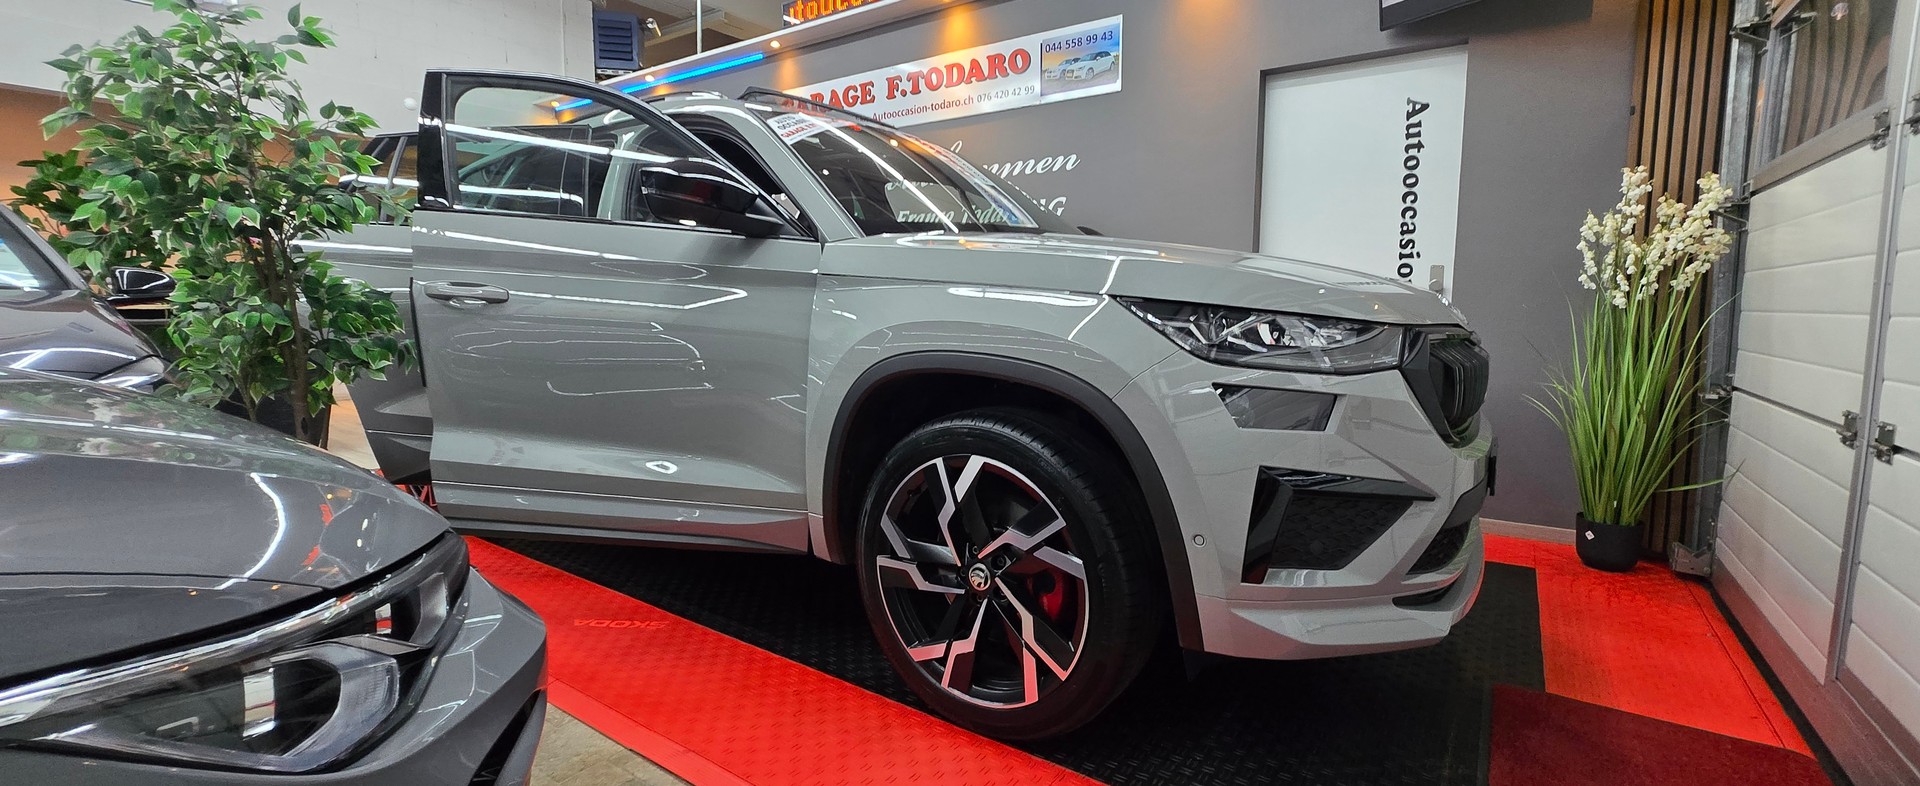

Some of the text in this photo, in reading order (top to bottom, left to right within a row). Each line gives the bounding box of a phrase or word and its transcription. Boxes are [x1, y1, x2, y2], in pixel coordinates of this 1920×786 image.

[1045, 30, 1113, 53] 044 558 99 43
[886, 48, 1031, 100] F.TODARO
[976, 93, 992, 104] 076
[994, 89, 1010, 100] 420
[1011, 86, 1022, 97] 42
[1024, 84, 1035, 95] 99
[1397, 97, 1430, 285] Autooccasio
